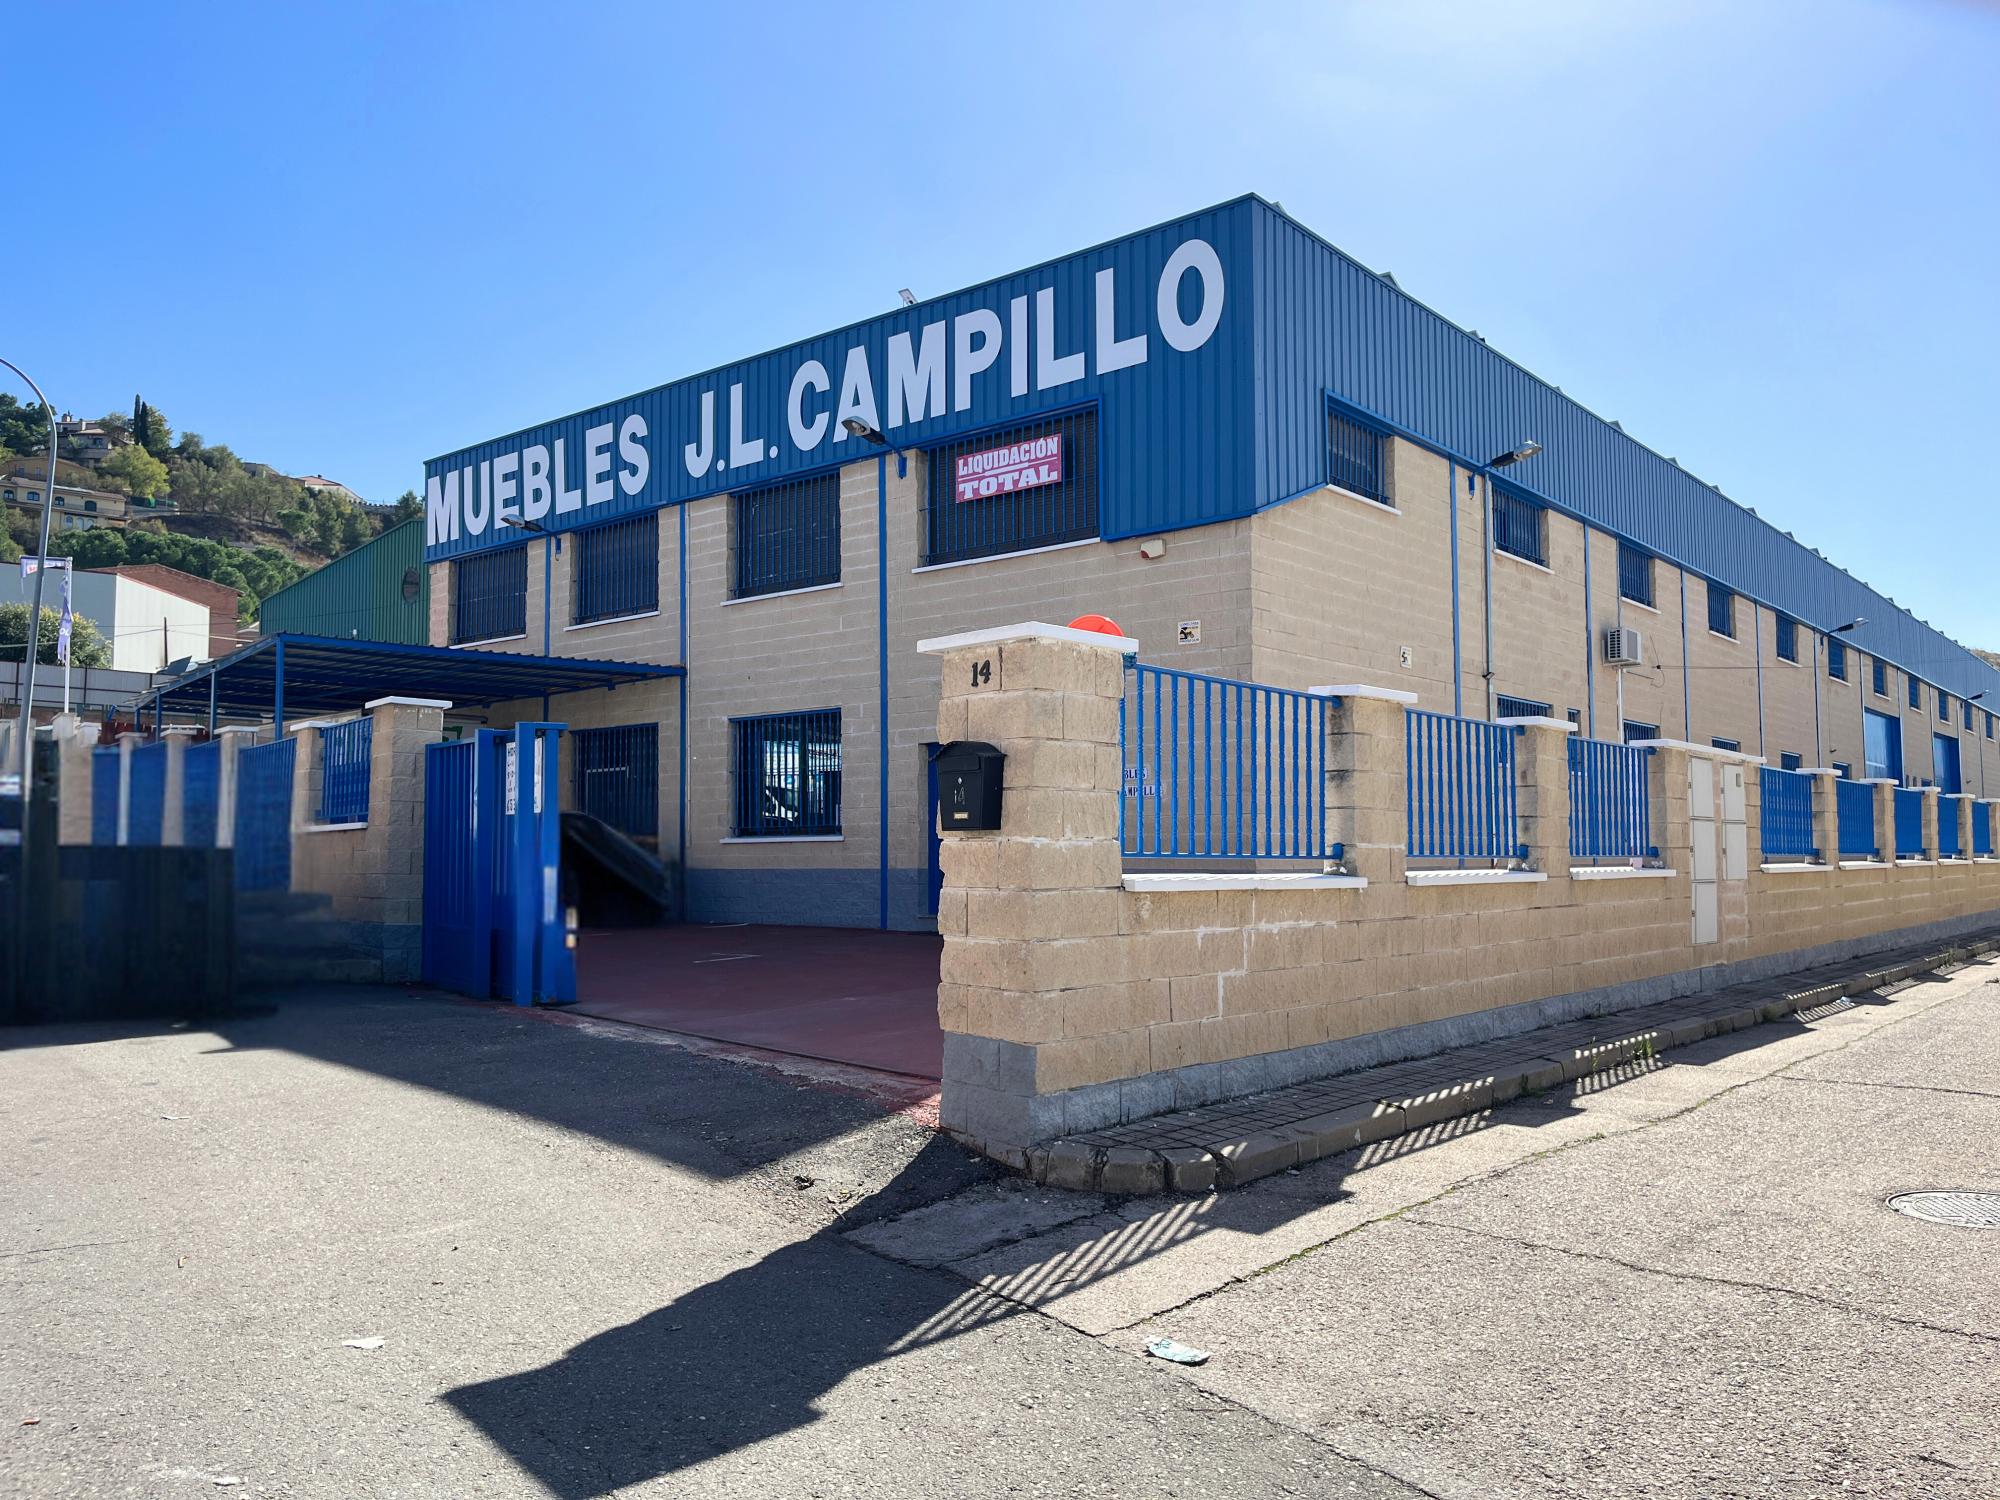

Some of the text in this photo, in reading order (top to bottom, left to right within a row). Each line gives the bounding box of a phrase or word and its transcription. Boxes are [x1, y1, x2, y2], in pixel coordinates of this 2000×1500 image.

[958, 437, 1058, 476] LIQUIDACIÓN
[427, 414, 649, 546] MUEBLES
[958, 464, 1057, 499] TOTAL
[971, 659, 991, 687] 14
